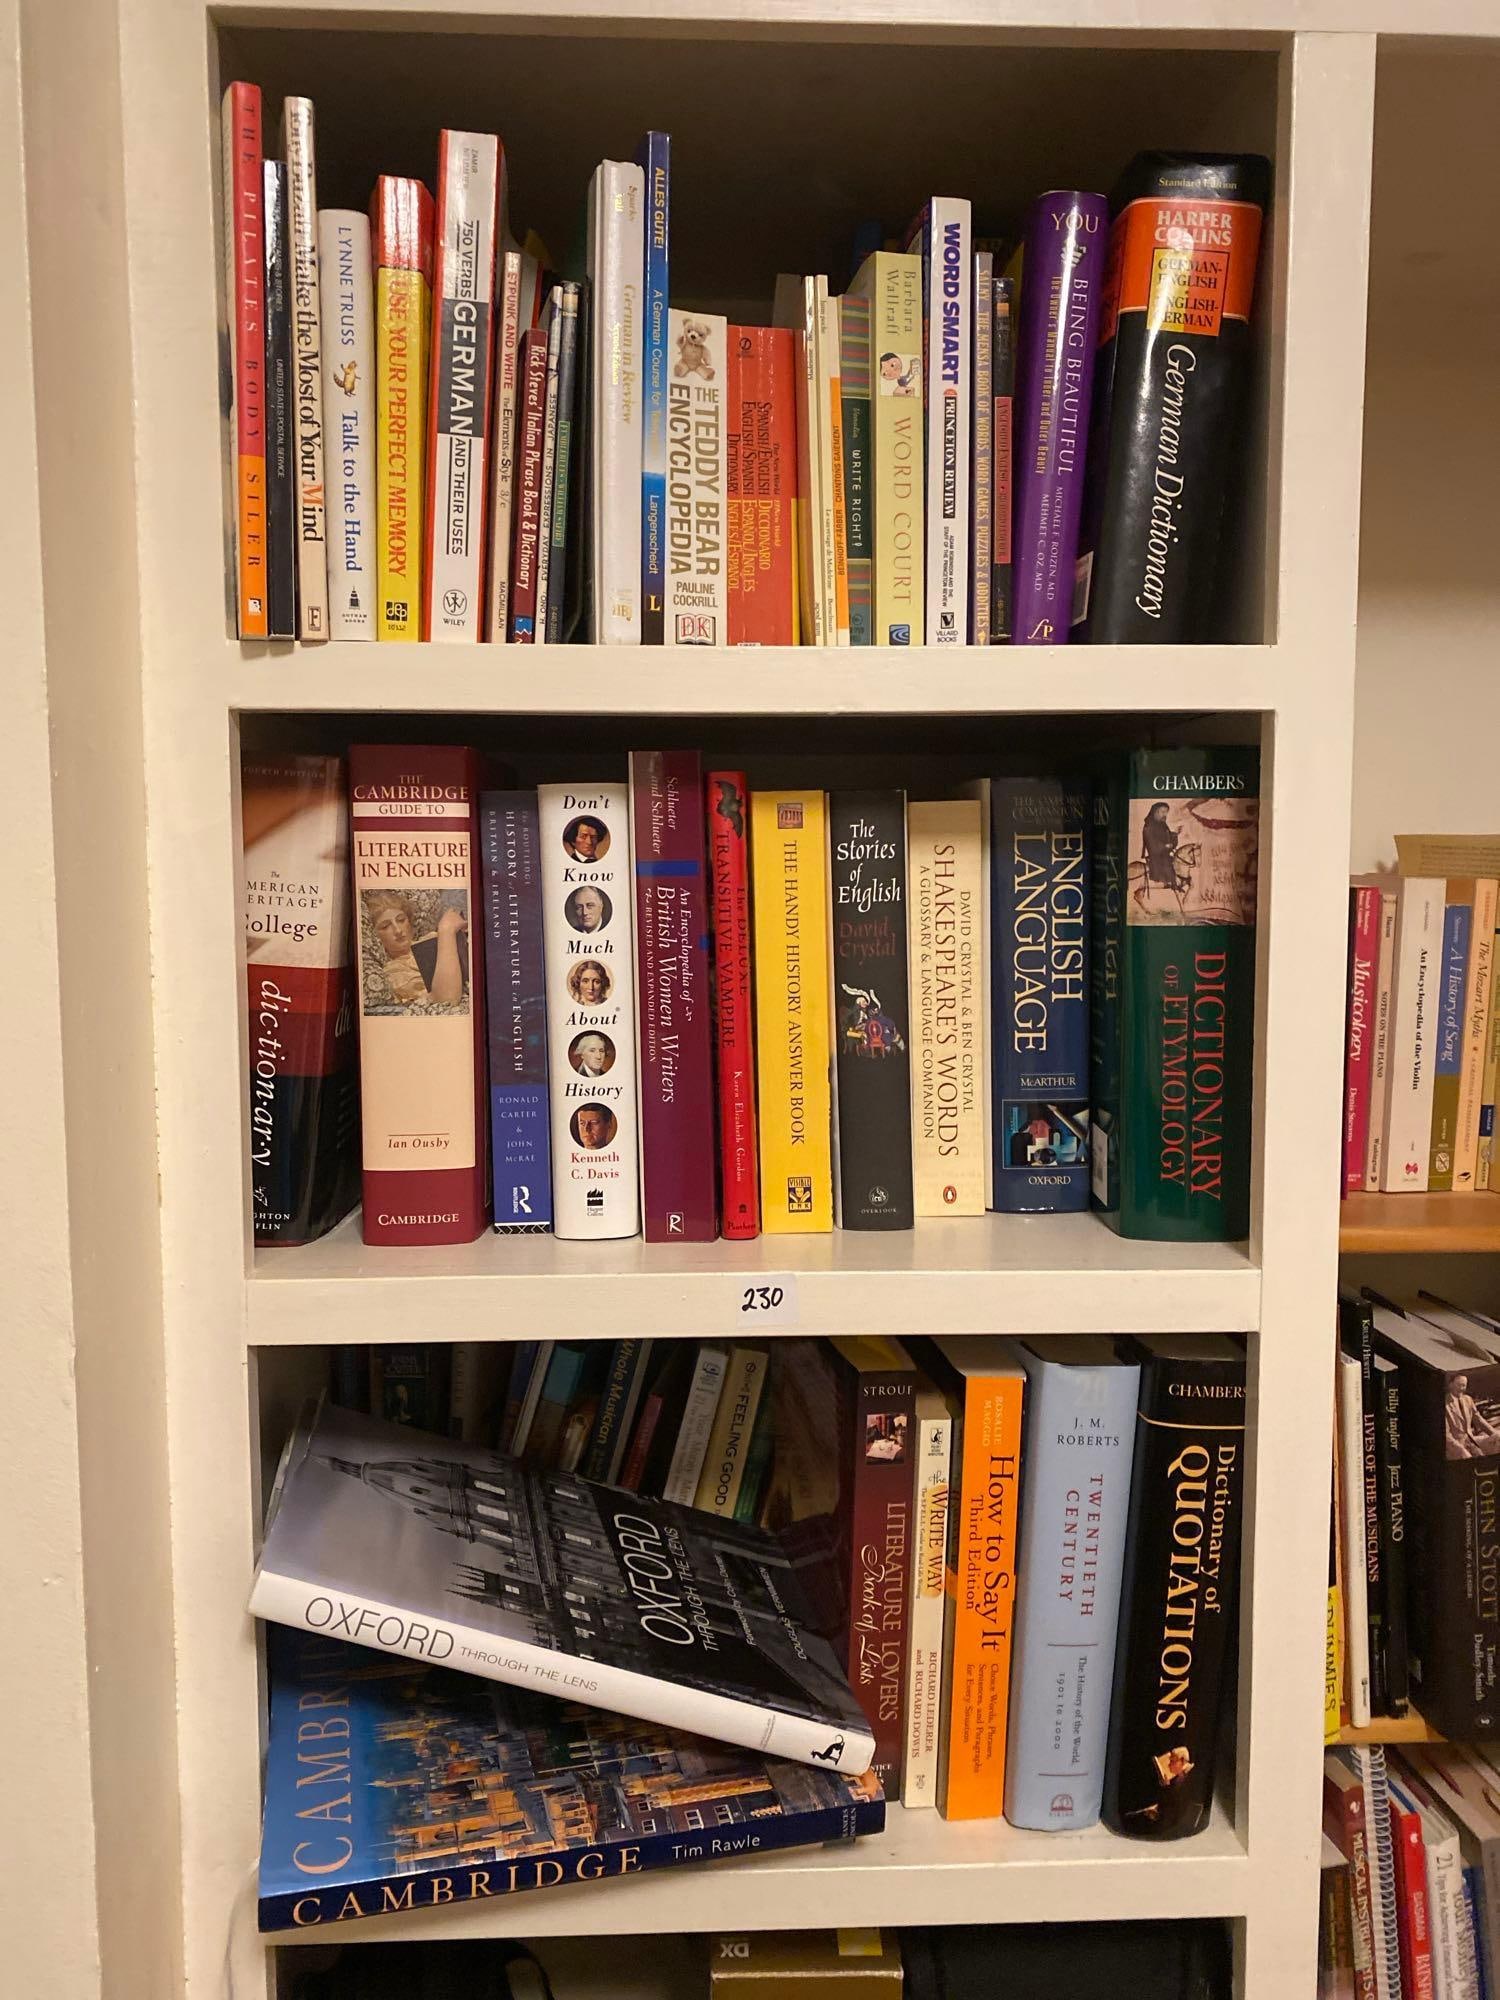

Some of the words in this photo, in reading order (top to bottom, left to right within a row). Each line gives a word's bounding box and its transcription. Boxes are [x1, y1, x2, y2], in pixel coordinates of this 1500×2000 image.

[243, 103, 255, 164] THE
[654, 166, 666, 208] ALLES
[462, 221, 474, 246] 750
[654, 210, 665, 250] GUTE!
[243, 191, 258, 333] PILATES
[339, 226, 353, 286] LYNNE
[460, 251, 474, 299] VERBS
[943, 226, 961, 299] WORD
[653, 290, 664, 298] A
[886, 269, 900, 337] Wallraff
[904, 271, 917, 333] Barbara
[1068, 277, 1089, 349] BEING
[341, 293, 355, 347] TRUSS
[651, 300, 665, 345] German
[942, 301, 961, 384] SMART
[245, 359, 259, 401] BODY
[449, 302, 478, 435] GERMAN
[650, 348, 664, 388] Course
[650, 390, 663, 407] for
[1058, 358, 1082, 476] BEAUTIFUL
[1157, 343, 1197, 464] German
[342, 410, 360, 452] Talk
[694, 405, 720, 494] TEDDY
[945, 399, 957, 465] PRINCETON
[343, 460, 358, 476] to
[454, 438, 467, 468] AND
[852, 449, 864, 492] WRITE
[344, 483, 361, 514] the
[452, 474, 466, 513] THEIR
[669, 382, 691, 576] ENCYCLOPEDIA
[944, 469, 956, 518] REVIEW
[246, 473, 261, 568] SILER
[450, 518, 464, 555] USES
[646, 494, 660, 575] Langenscheidt
[695, 501, 721, 576] BEAR
[852, 497, 864, 548] RIGHT!
[345, 519, 364, 572] Hand
[1134, 466, 1185, 619] Dictionary
[497, 580, 507, 630] MACMILLAN
[673, 595, 719, 608] COCKRILL
[676, 582, 715, 595] PAULINE
[444, 618, 465, 627] WILEY
[353, 784, 469, 801] CAMBRIDGE
[650, 775, 664, 797] and
[666, 776, 680, 830] Schlueter
[1152, 774, 1246, 792] CHAMBERS
[378, 803, 423, 816] GUIDE
[426, 803, 445, 815] TO
[651, 800, 665, 855] Schlueter
[849, 818, 877, 839] The
[358, 840, 469, 858] LITERATURE
[361, 863, 381, 878] IN
[386, 861, 467, 878] ENGLISH
[783, 840, 798, 874] THE
[836, 839, 896, 862] Stories
[919, 865, 931, 874] A
[561, 867, 615, 883] Know
[837, 877, 902, 914] English
[656, 885, 678, 949] British
[679, 887, 692, 907] An
[784, 878, 800, 939] HANDY
[919, 878, 932, 951] GLOSSARY
[960, 891, 972, 937] DAVID
[1051, 831, 1084, 1003] ENGLISH
[566, 939, 616, 955] Much
[678, 908, 696, 987] Encyclopedia
[921, 953, 931, 965] &
[934, 844, 958, 1046] SHAKESPEARE'S
[1013, 831, 1048, 1055] LANGUAGE
[1420, 948, 1429, 963] An
[1450, 947, 1464, 960] A
[1478, 941, 1491, 960] The
[658, 956, 678, 1028] Women
[786, 943, 803, 1015] HISTORY
[961, 941, 973, 1002] CRYSTAL
[1444, 965, 1464, 1014] History
[1474, 962, 1488, 1004] Mozart
[681, 990, 695, 1002] of
[920, 968, 934, 1045] LANGUAGE
[962, 1007, 972, 1018] &
[1349, 957, 1373, 1062] Musicology
[1415, 964, 1428, 1029] Encyclopedia
[961, 1022, 973, 1049] BEN
[1414, 1031, 1424, 1042] of
[1444, 1015, 1461, 1028] of
[1470, 1005, 1485, 1038] Myths
[788, 1020, 804, 1092] ANSWER
[1413, 1043, 1423, 1060] the
[1440, 1030, 1460, 1063] Song
[660, 1034, 681, 1104] Writers
[733, 1070, 743, 1099] Karen
[962, 1053, 974, 1113] CRYSTAL
[1020, 1076, 1077, 1088] McARTHUR
[1191, 951, 1227, 1201] DICTIONARY
[1411, 1060, 1423, 1091] Violin
[564, 1083, 624, 1101] History
[921, 1049, 935, 1139] COMPANION
[937, 1055, 959, 1157] WORDS
[1348, 1087, 1359, 1111] Denis
[734, 1102, 745, 1143] Elizabeth
[790, 1097, 805, 1146] BOOK
[1346, 1112, 1358, 1142] Stevens
[387, 1138, 408, 1149] Ian
[411, 1137, 450, 1150] Ousby
[570, 1151, 621, 1164] Kenneth
[570, 1169, 584, 1180] C.
[587, 1167, 621, 1180] Davis
[735, 1147, 746, 1183] Gordon
[1028, 1175, 1072, 1186] OXFORD
[377, 1212, 461, 1226] CAMBRIDGE
[741, 1286, 784, 1312] 230
[1387, 1388, 1401, 1414] billy
[1056, 1433, 1120, 1447] ROBERTS
[1364, 1413, 1377, 1453] LIVES
[1388, 1417, 1402, 1452] taylor
[1365, 1454, 1377, 1473] OF
[1387, 1464, 1402, 1490] Jazz
[987, 1455, 1016, 1527] How
[1366, 1475, 1378, 1505] THE
[1474, 1466, 1498, 1533] JOHN
[968, 1494, 984, 1542] Third
[1200, 1444, 1237, 1581] Dictionary
[1390, 1492, 1404, 1543] PIANO
[881, 1501, 907, 1631] LITERATURE
[984, 1534, 1005, 1563] to
[1059, 1489, 1080, 1602] CENTURY
[1079, 1474, 1104, 1616] TWENTIETH
[1366, 1506, 1381, 1584] MUSICIANS
[965, 1548, 983, 1611] Edition
[975, 1571, 1011, 1624] Say
[1155, 1444, 1211, 1730] QUOTATIONS
[1203, 1586, 1221, 1614] of
[1480, 1545, 1500, 1622] STOTT
[304, 1596, 456, 1661] OXFORD
[460, 1643, 529, 1674] THROUGH
[534, 1666, 562, 1683] THE
[563, 1673, 600, 1693] LENS
[915, 1649, 925, 1664] and
[981, 1629, 1008, 1651] It
[879, 1640, 901, 1722] LOVER'S
[926, 1651, 939, 1701] RICHARD
[1486, 1645, 1497, 1688] Timothy
[913, 1670, 924, 1720] RICHARD
[911, 1721, 923, 1759] DOWIS
[925, 1702, 937, 1753] LEDERER
[670, 1844, 704, 1861] Tim
[711, 1835, 762, 1854] Rawle
[1435, 1851, 1455, 1872] 21
[292, 1845, 647, 1926] CAMBRIDGE
